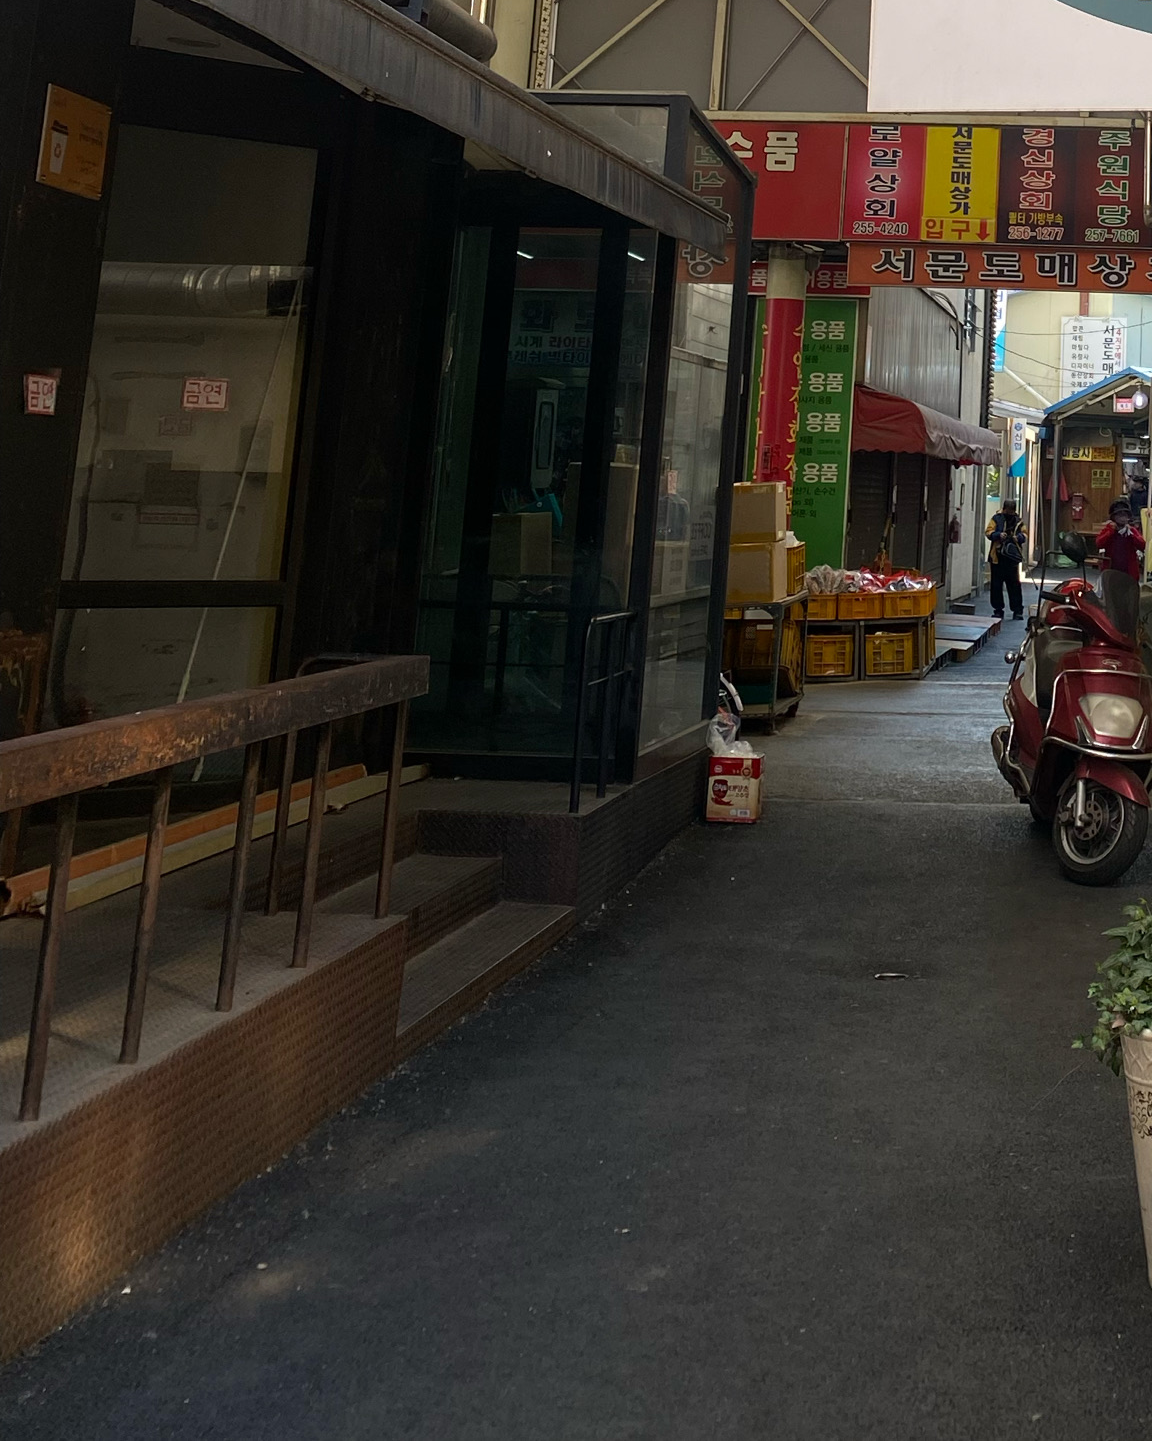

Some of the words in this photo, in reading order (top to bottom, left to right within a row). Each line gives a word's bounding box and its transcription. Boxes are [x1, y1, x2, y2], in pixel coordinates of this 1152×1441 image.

[863, 125, 902, 218] 로얄상회
[949, 126, 973, 215] 서문도매상가
[1019, 128, 1055, 211] 경신상회
[1096, 130, 1132, 227] 주원식당
[852, 222, 908, 236] 255-4240
[925, 219, 970, 240] 입구
[1008, 226, 1064, 241] 256-1277
[1085, 229, 1140, 244] 257-7661
[810, 321, 846, 341] 용품
[1102, 324, 1116, 380] 서문도매
[186, 382, 222, 405] 금연
[807, 373, 844, 393] 용품
[806, 412, 842, 433] 용품
[802, 462, 839, 484] 용품
